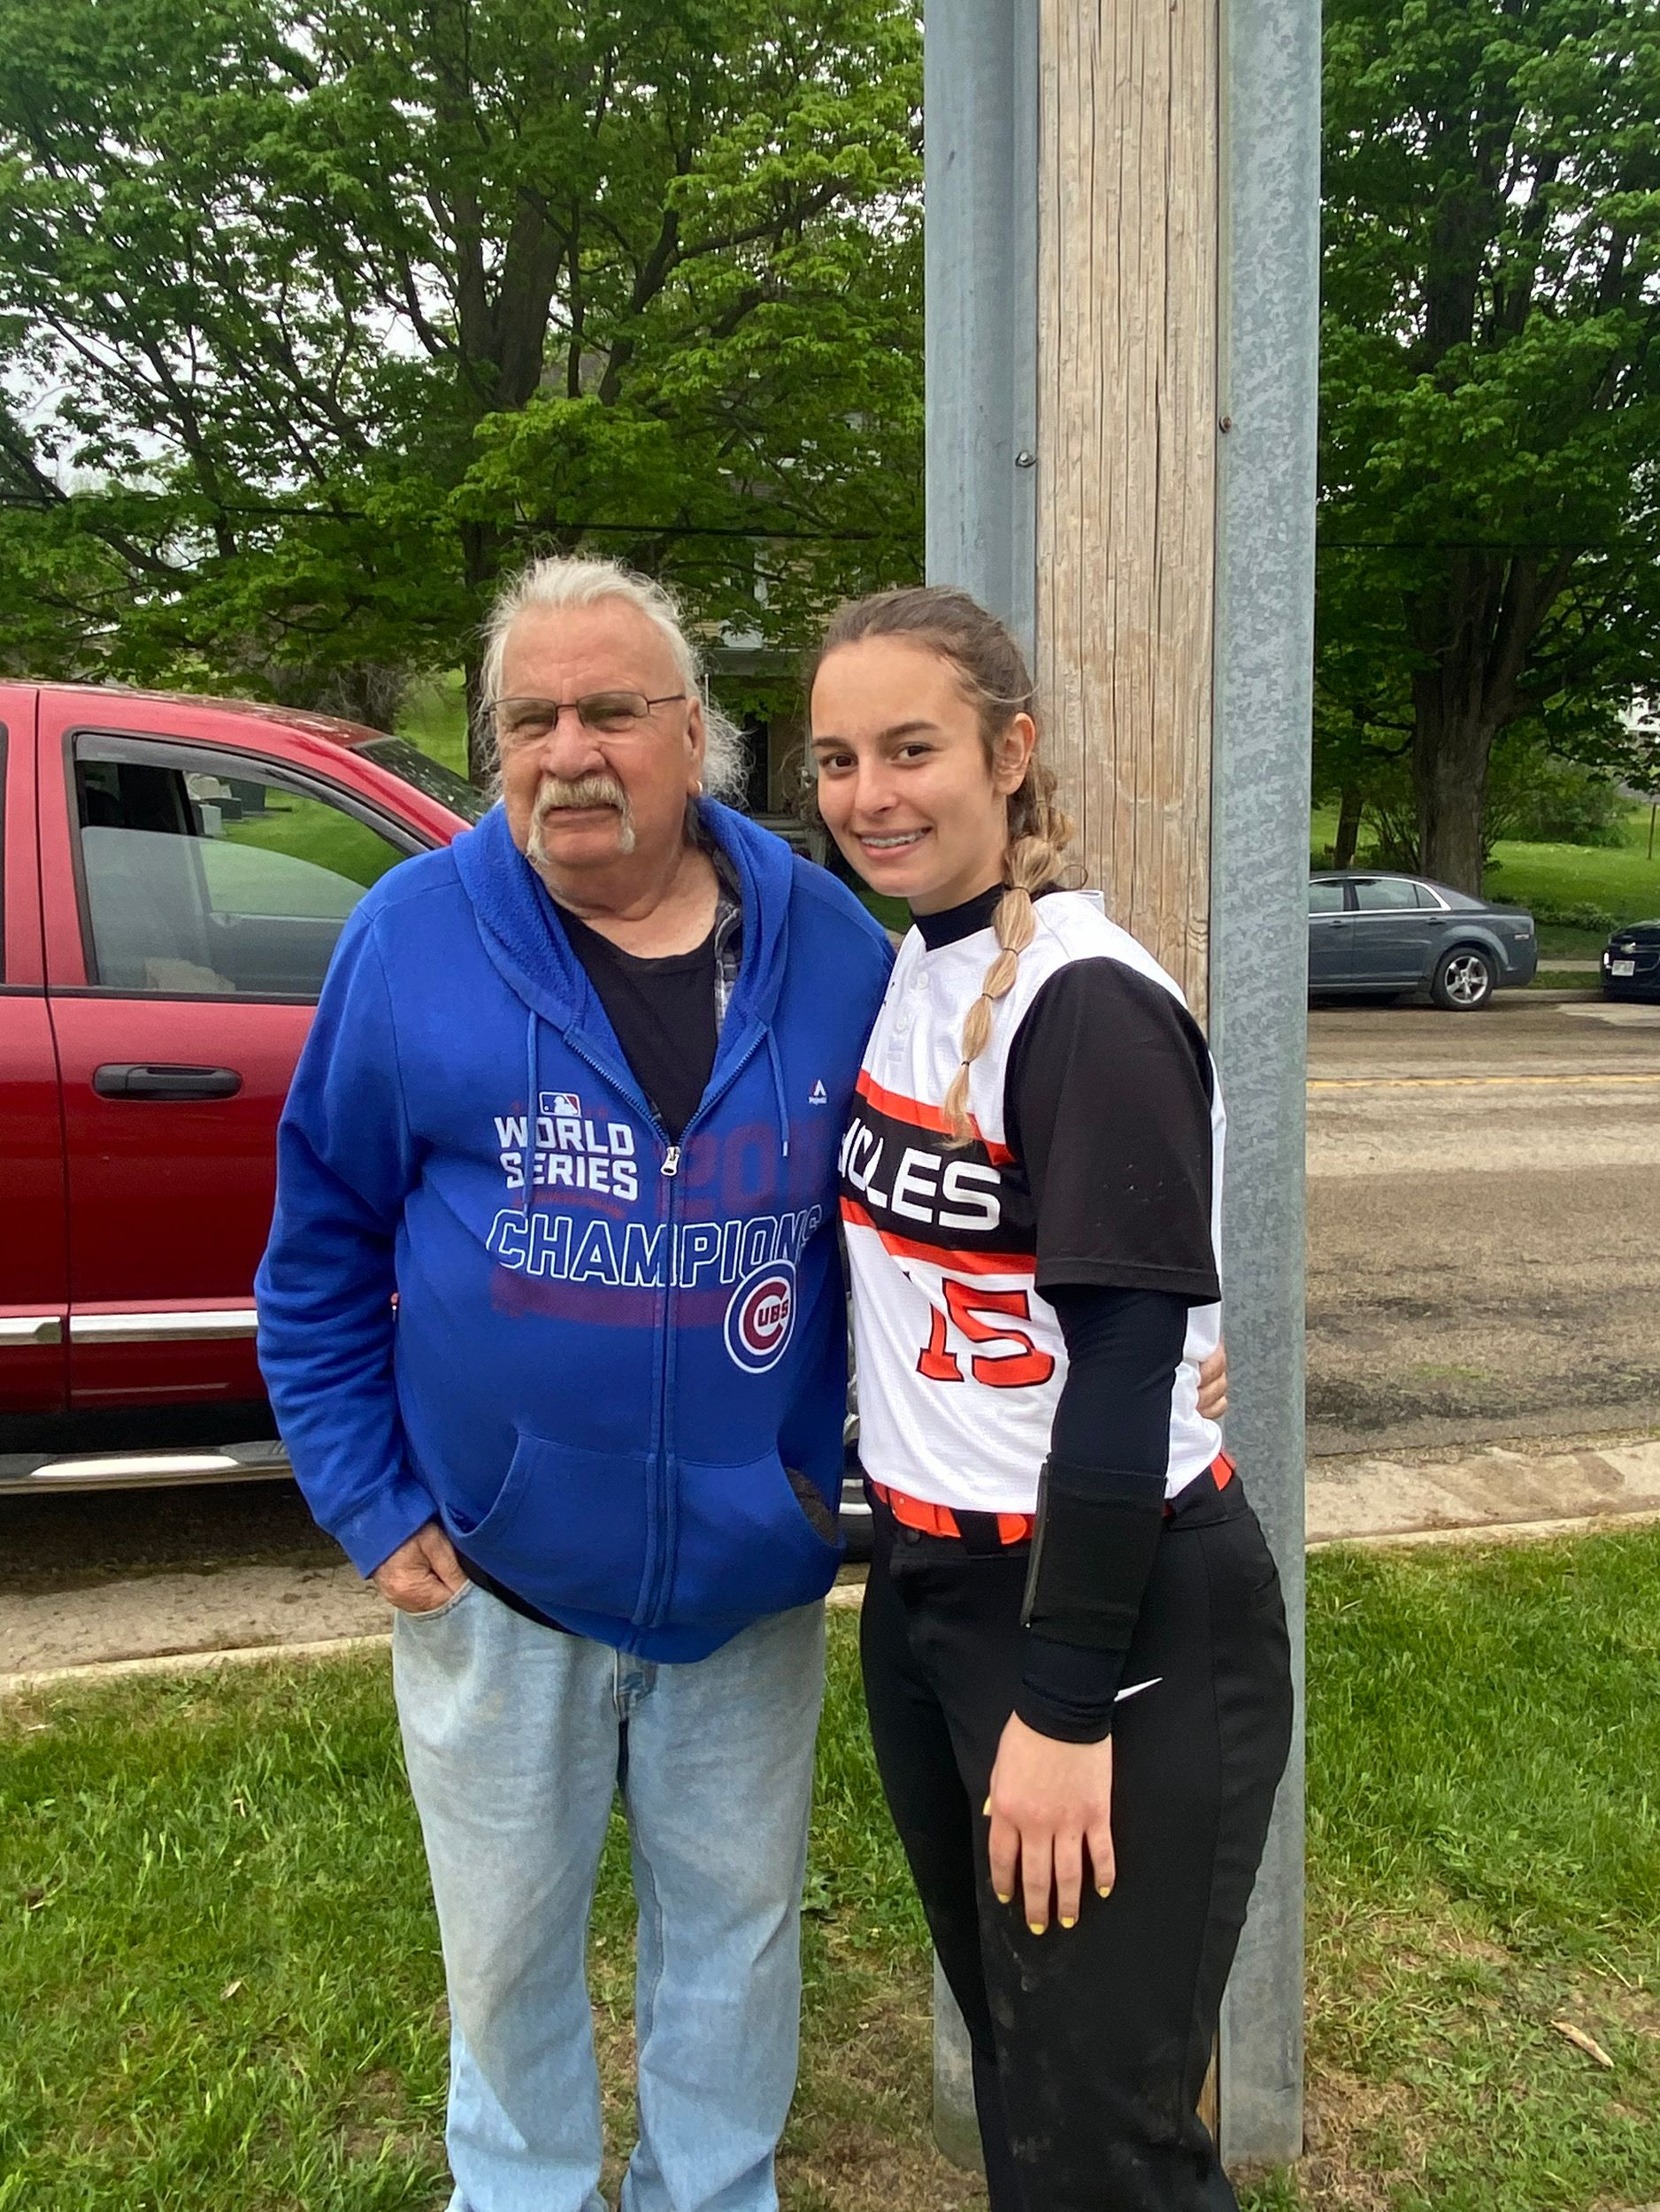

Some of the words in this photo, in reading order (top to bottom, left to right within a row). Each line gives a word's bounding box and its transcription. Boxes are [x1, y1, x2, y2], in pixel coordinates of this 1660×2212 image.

[494, 1116, 635, 1156] WORLD
[499, 1152, 638, 1202] SERIES
[742, 1279, 791, 1351] CUBS
[915, 1277, 1056, 1389] 15
